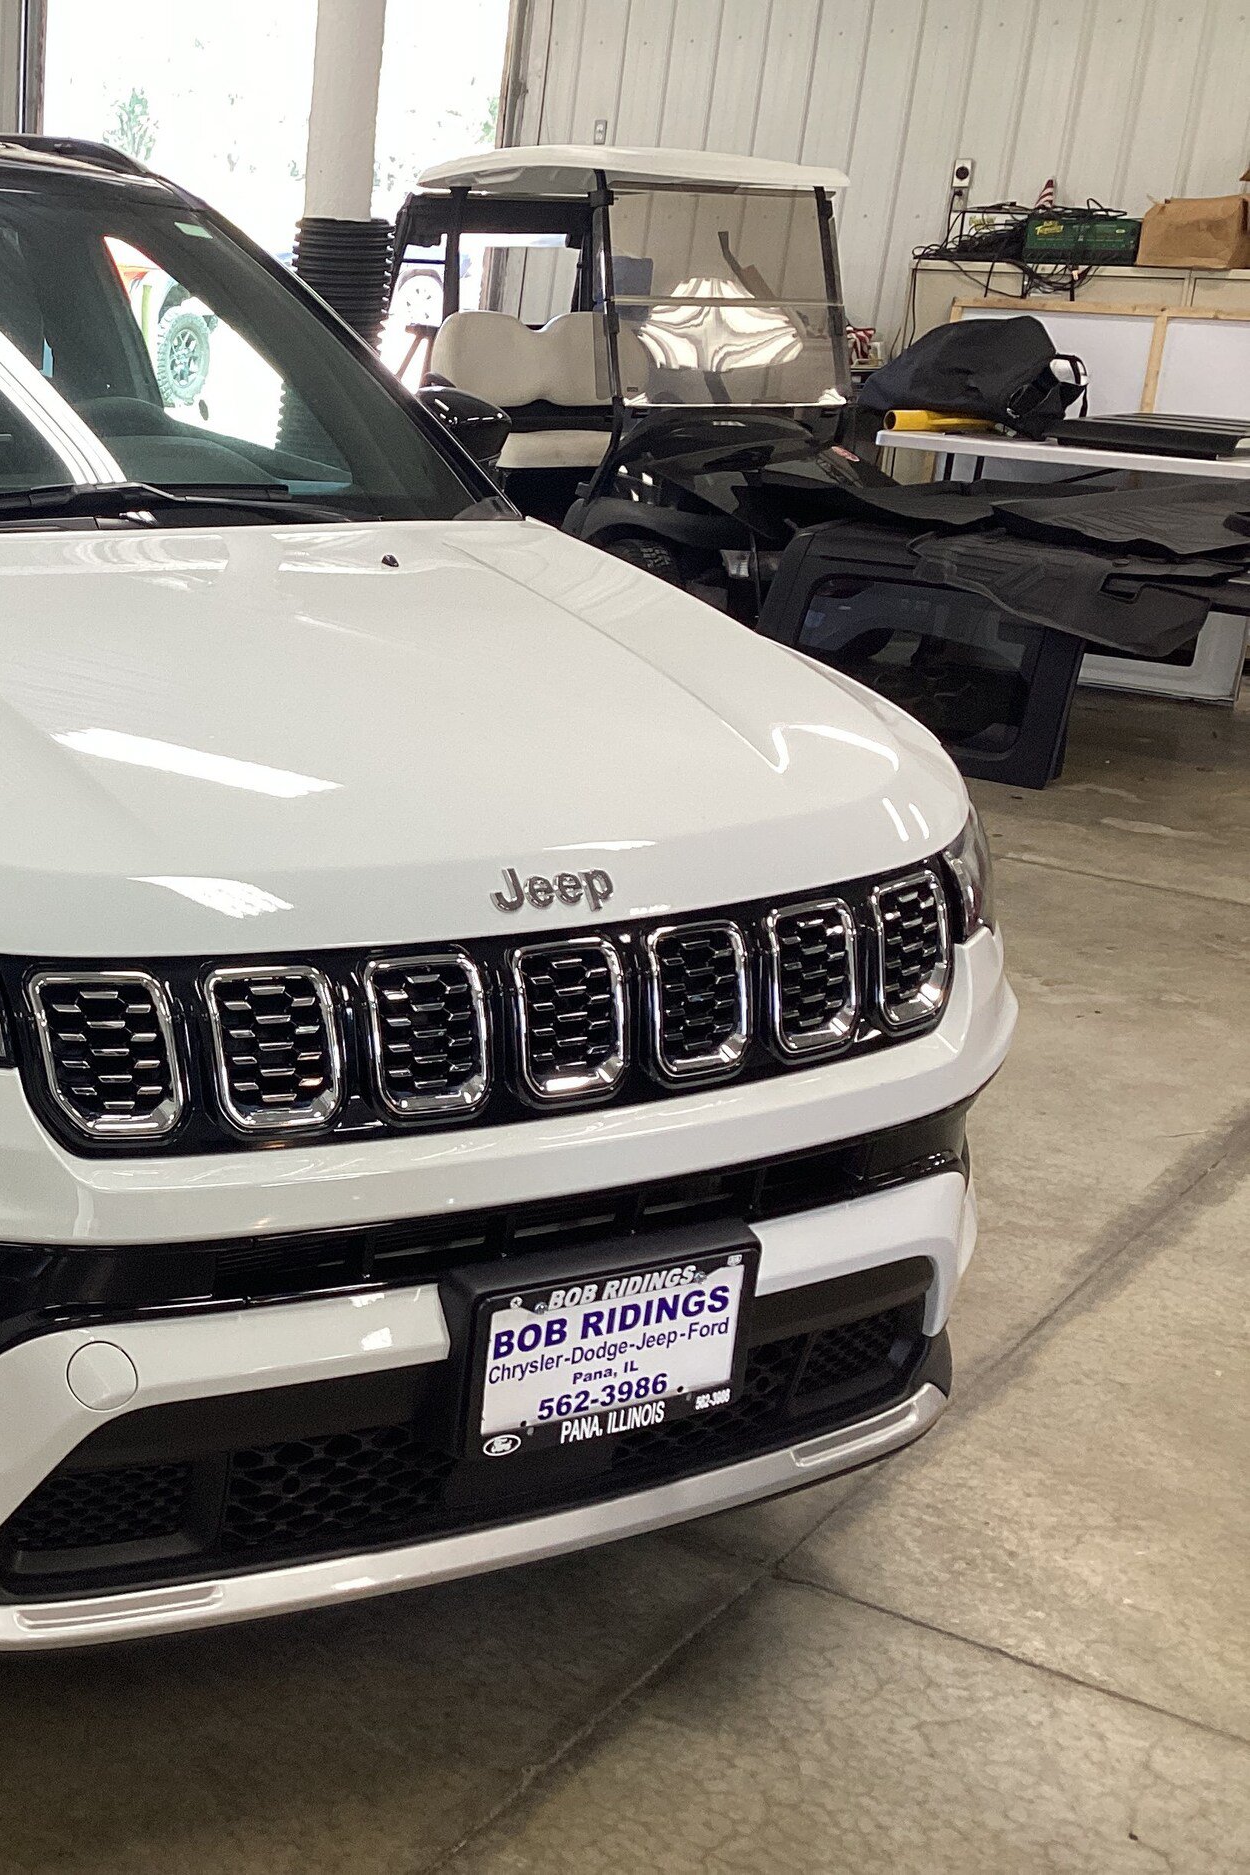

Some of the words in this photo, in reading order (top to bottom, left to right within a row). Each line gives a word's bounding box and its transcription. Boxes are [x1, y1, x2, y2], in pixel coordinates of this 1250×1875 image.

[490, 868, 614, 912] Jeep
[548, 1284, 598, 1310] BOB
[601, 1265, 697, 1301] RIDINGS
[493, 1319, 568, 1360] BOB
[580, 1285, 731, 1340] RIDINGS
[488, 1317, 730, 1385] Chrysler-Dodge-Jeep-Ford
[572, 1366, 618, 1385] Pana,
[624, 1359, 639, 1374] IL
[537, 1372, 668, 1421] 562-3986
[606, 1401, 666, 1434] ILLINOIS
